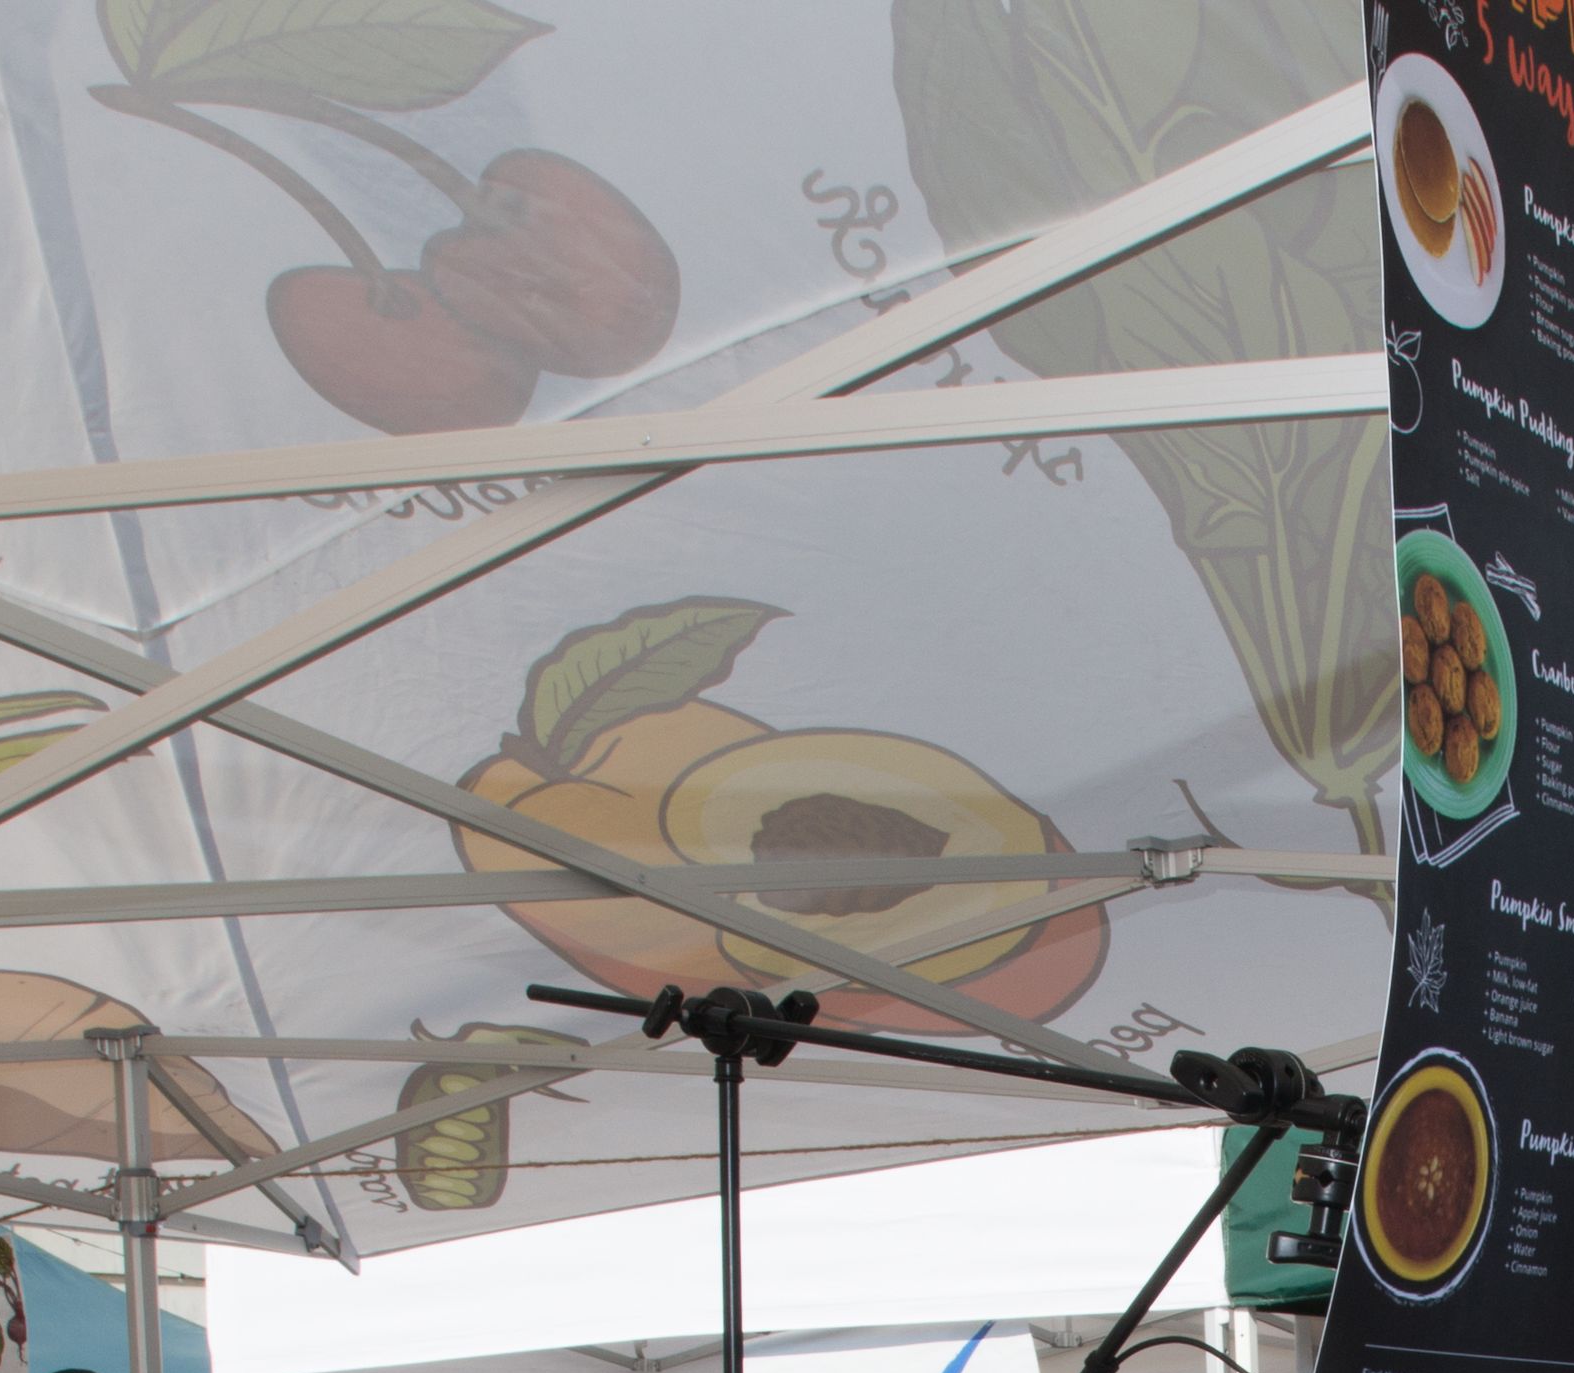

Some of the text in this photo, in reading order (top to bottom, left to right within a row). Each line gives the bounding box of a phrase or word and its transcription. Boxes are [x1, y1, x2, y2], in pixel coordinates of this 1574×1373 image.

[1452, 358, 1516, 420] Pumpkin
[1491, 879, 1553, 932] Pumpkin
[1494, 951, 1527, 970] Pumpkin
[1491, 989, 1538, 1013] Orange juice
[1490, 1008, 1519, 1027] Banana
[1488, 1027, 1554, 1057] Light brown sugar
[1515, 1224, 1538, 1239] Onion
[1513, 1242, 1536, 1257] Water
[1510, 1261, 1548, 1277] Cinnamon
